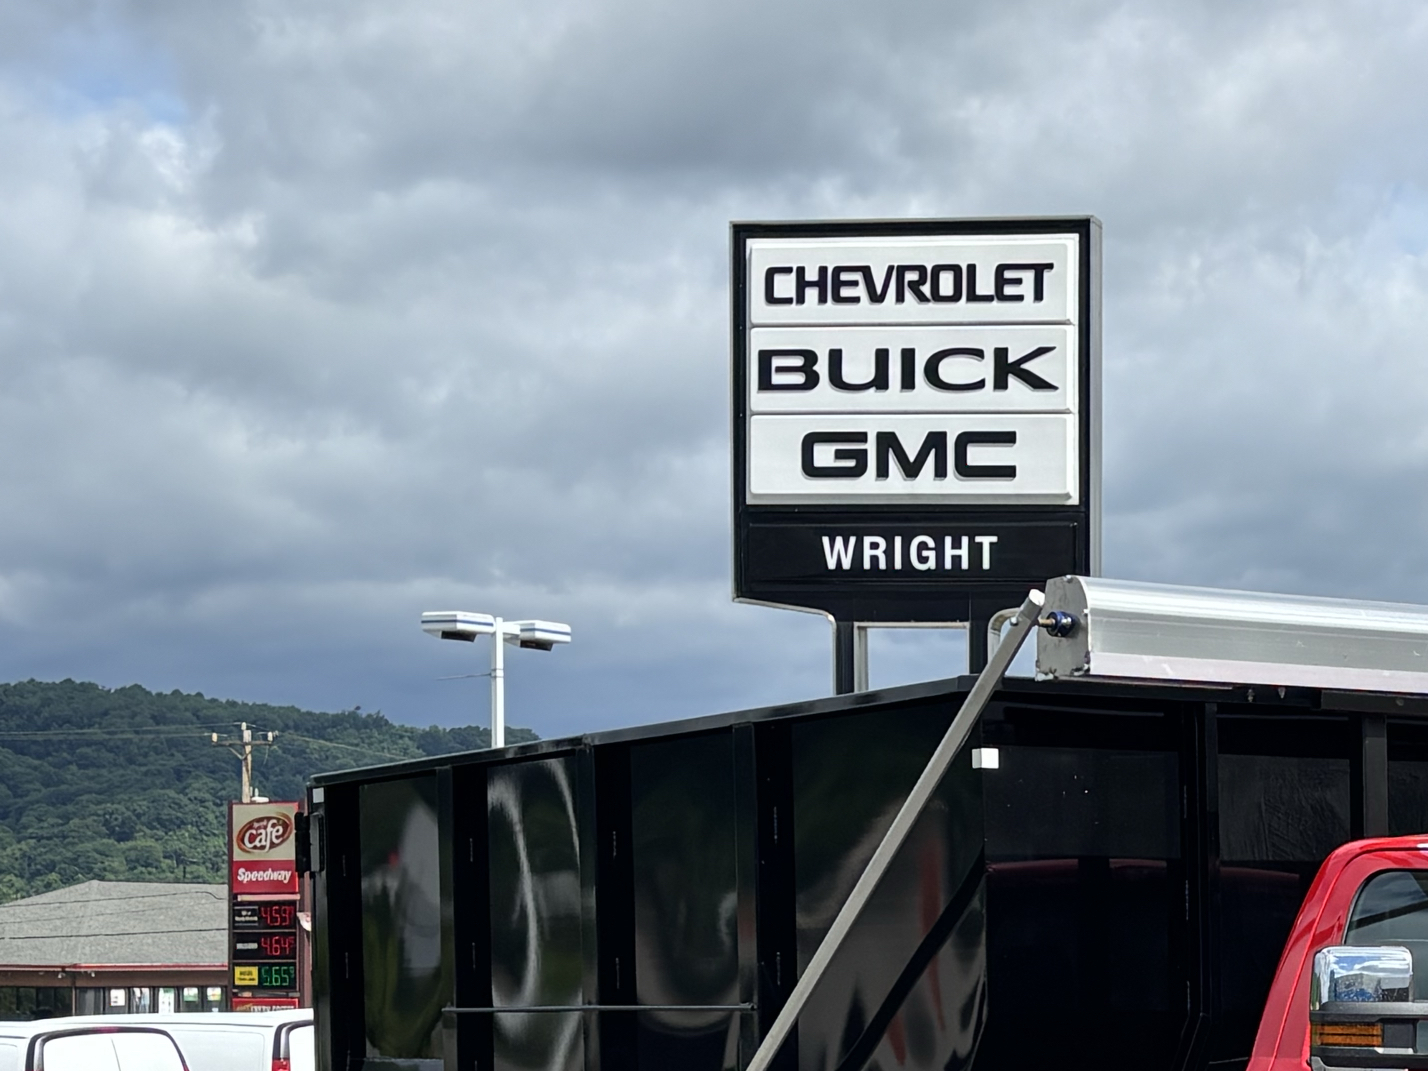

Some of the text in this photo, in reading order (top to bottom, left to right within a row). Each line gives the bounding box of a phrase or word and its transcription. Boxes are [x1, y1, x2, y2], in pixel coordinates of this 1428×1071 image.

[764, 262, 1054, 305] CHEVROLET
[757, 346, 1060, 392] BUICK
[801, 430, 1017, 480] GMC
[822, 535, 999, 571] WRIGHT
[237, 867, 292, 884] Speedway
